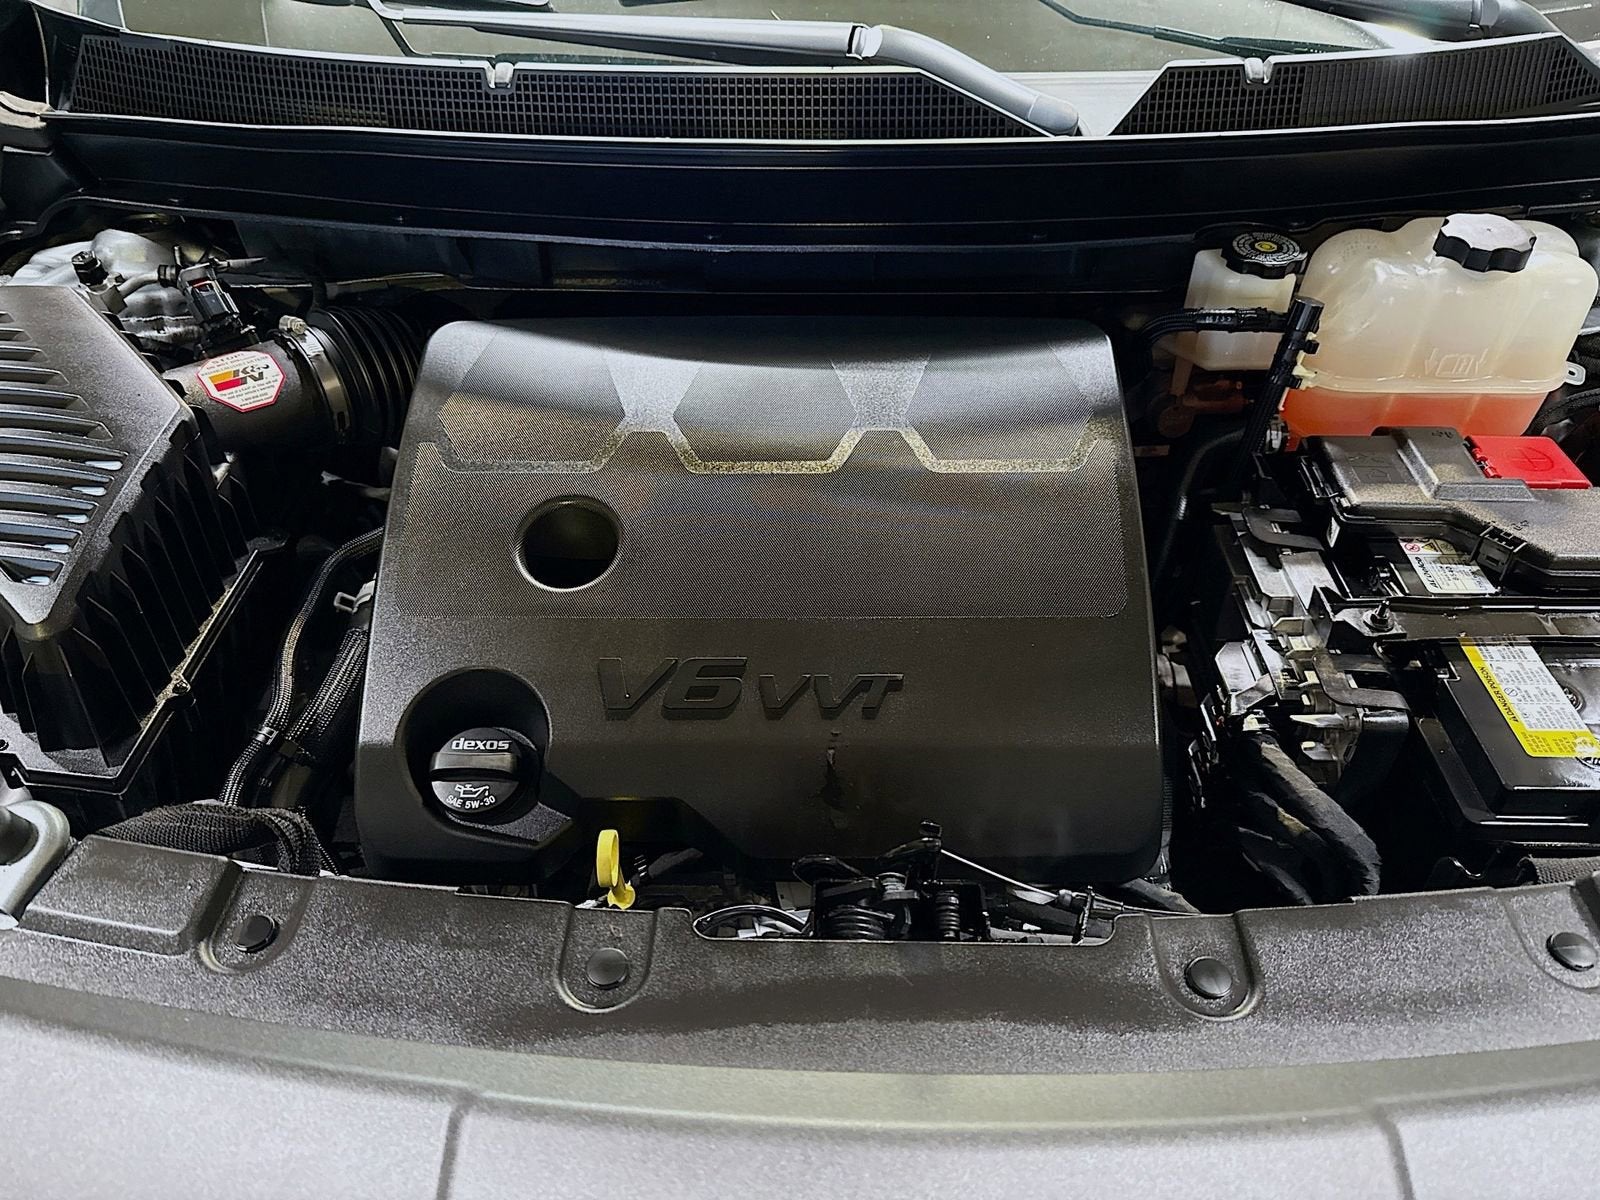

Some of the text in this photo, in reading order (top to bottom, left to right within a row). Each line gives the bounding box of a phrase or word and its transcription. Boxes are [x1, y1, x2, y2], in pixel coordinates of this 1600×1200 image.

[597, 656, 904, 718] V6 VVT
[1478, 666, 1515, 716] DANGER POISON
[451, 737, 512, 750] dexos
[446, 794, 496, 809] SAE 5W-30
